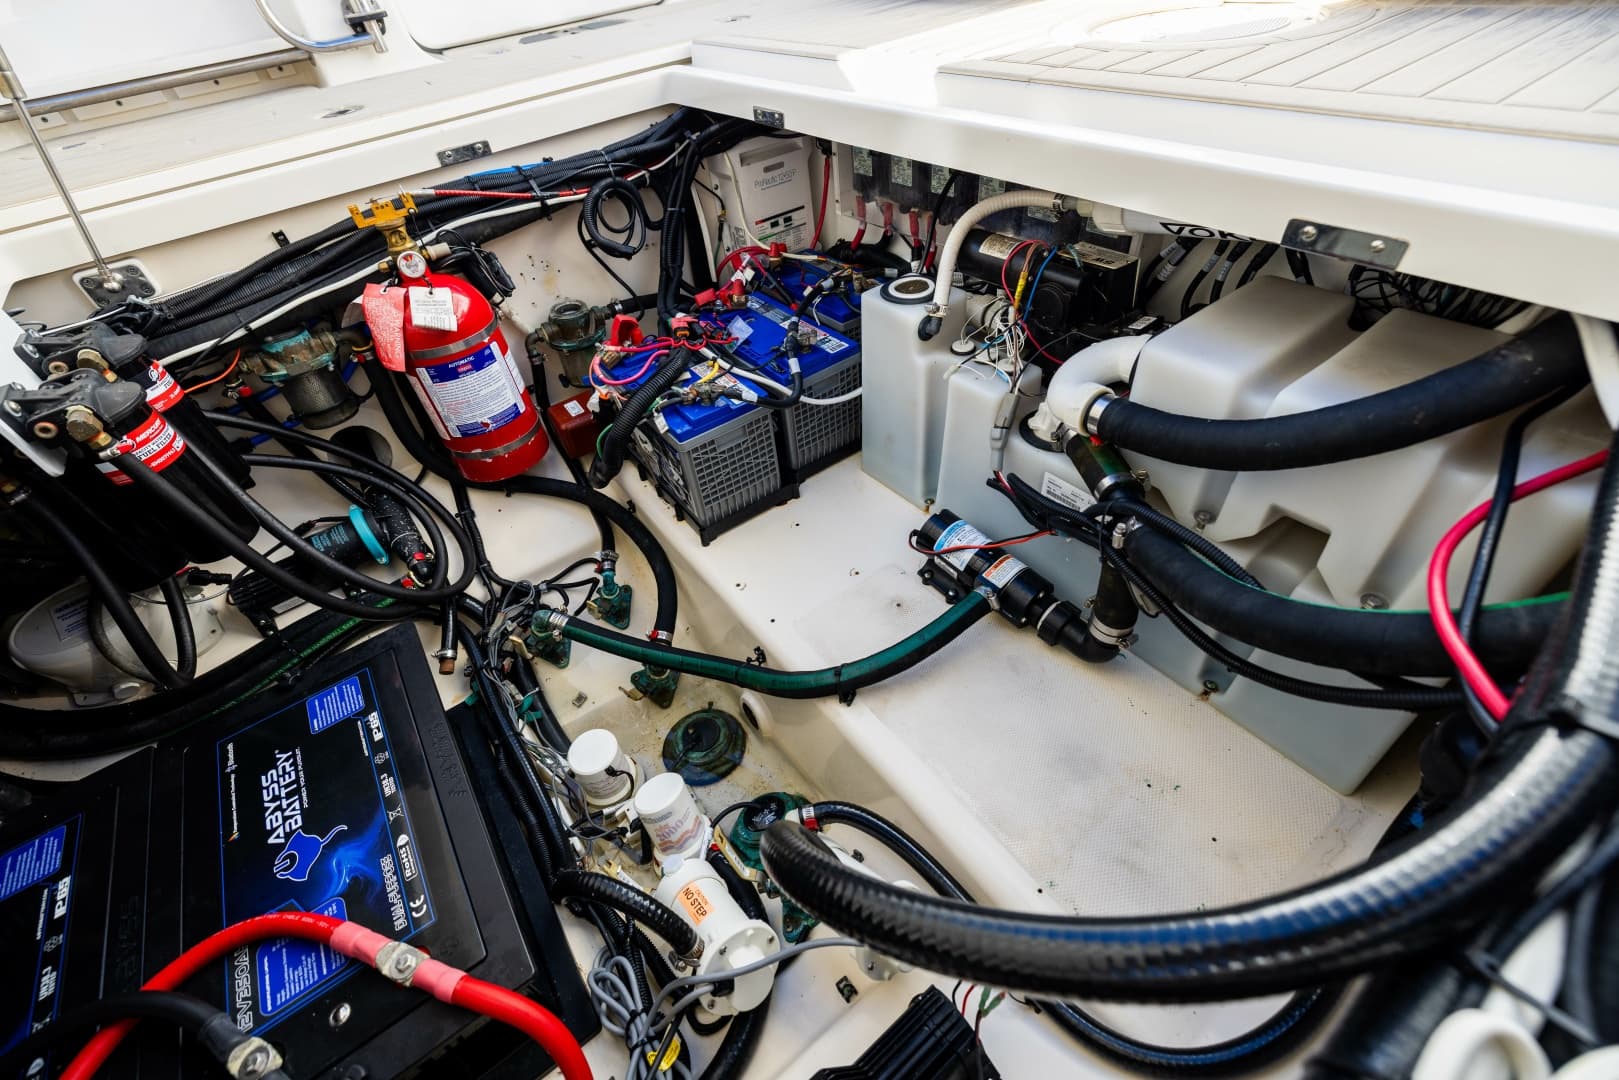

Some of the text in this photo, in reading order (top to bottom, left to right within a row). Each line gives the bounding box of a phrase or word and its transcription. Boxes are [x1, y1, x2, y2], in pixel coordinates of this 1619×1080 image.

[368, 711, 384, 742] IP65
[261, 768, 286, 844] ABYSS
[275, 750, 303, 833] BATTERY
[400, 847, 412, 878] RoHS
[53, 875, 72, 920] IP65
[682, 887, 708, 917] NO STEP
